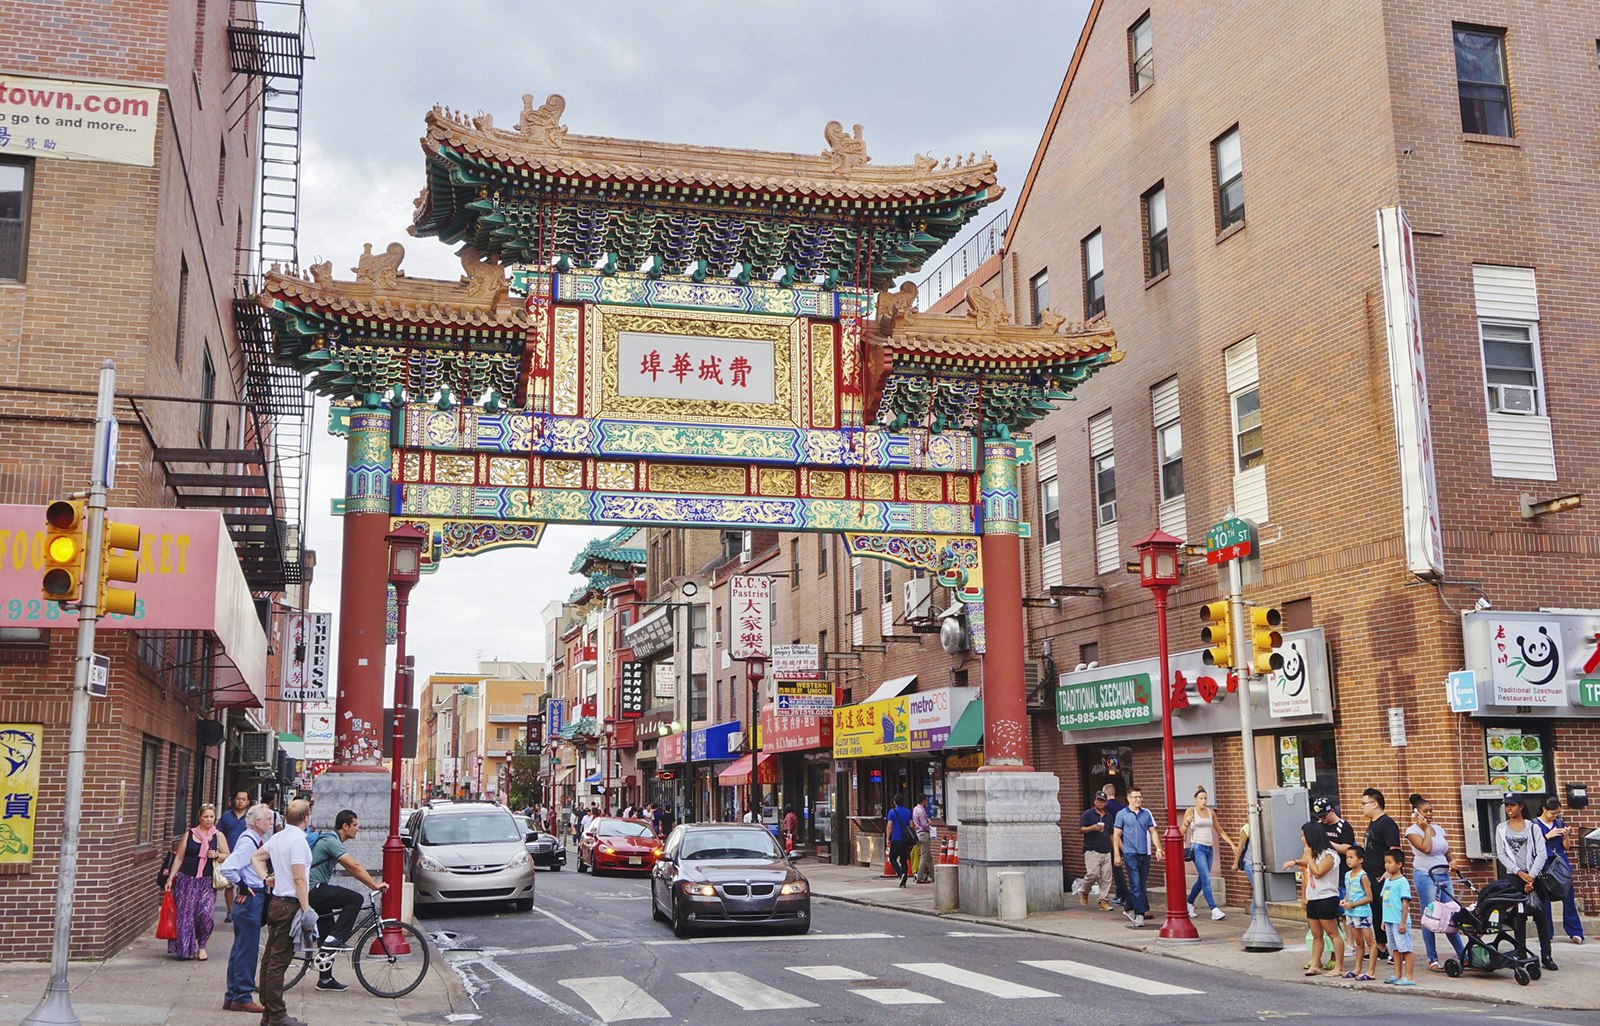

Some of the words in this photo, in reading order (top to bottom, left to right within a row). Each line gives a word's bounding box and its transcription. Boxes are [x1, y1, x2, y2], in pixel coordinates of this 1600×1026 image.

[11, 115, 29, 125] go
[35, 116, 49, 125] to
[55, 118, 82, 128] and
[1215, 529, 1235, 548] 10TH
[1238, 529, 1248, 541] ST
[733, 589, 768, 598] Pastries
[312, 615, 327, 688] EMPRESS
[284, 690, 326, 699] GARDEN
[633, 663, 642, 711] PENANG
[1059, 686, 1098, 712] TRADITIONAL
[1100, 680, 1135, 708] SZECHUAN
[1516, 705, 1531, 713] 935
[307, 730, 333, 738] Sanrio
[3, 793, 32, 819] 貨
